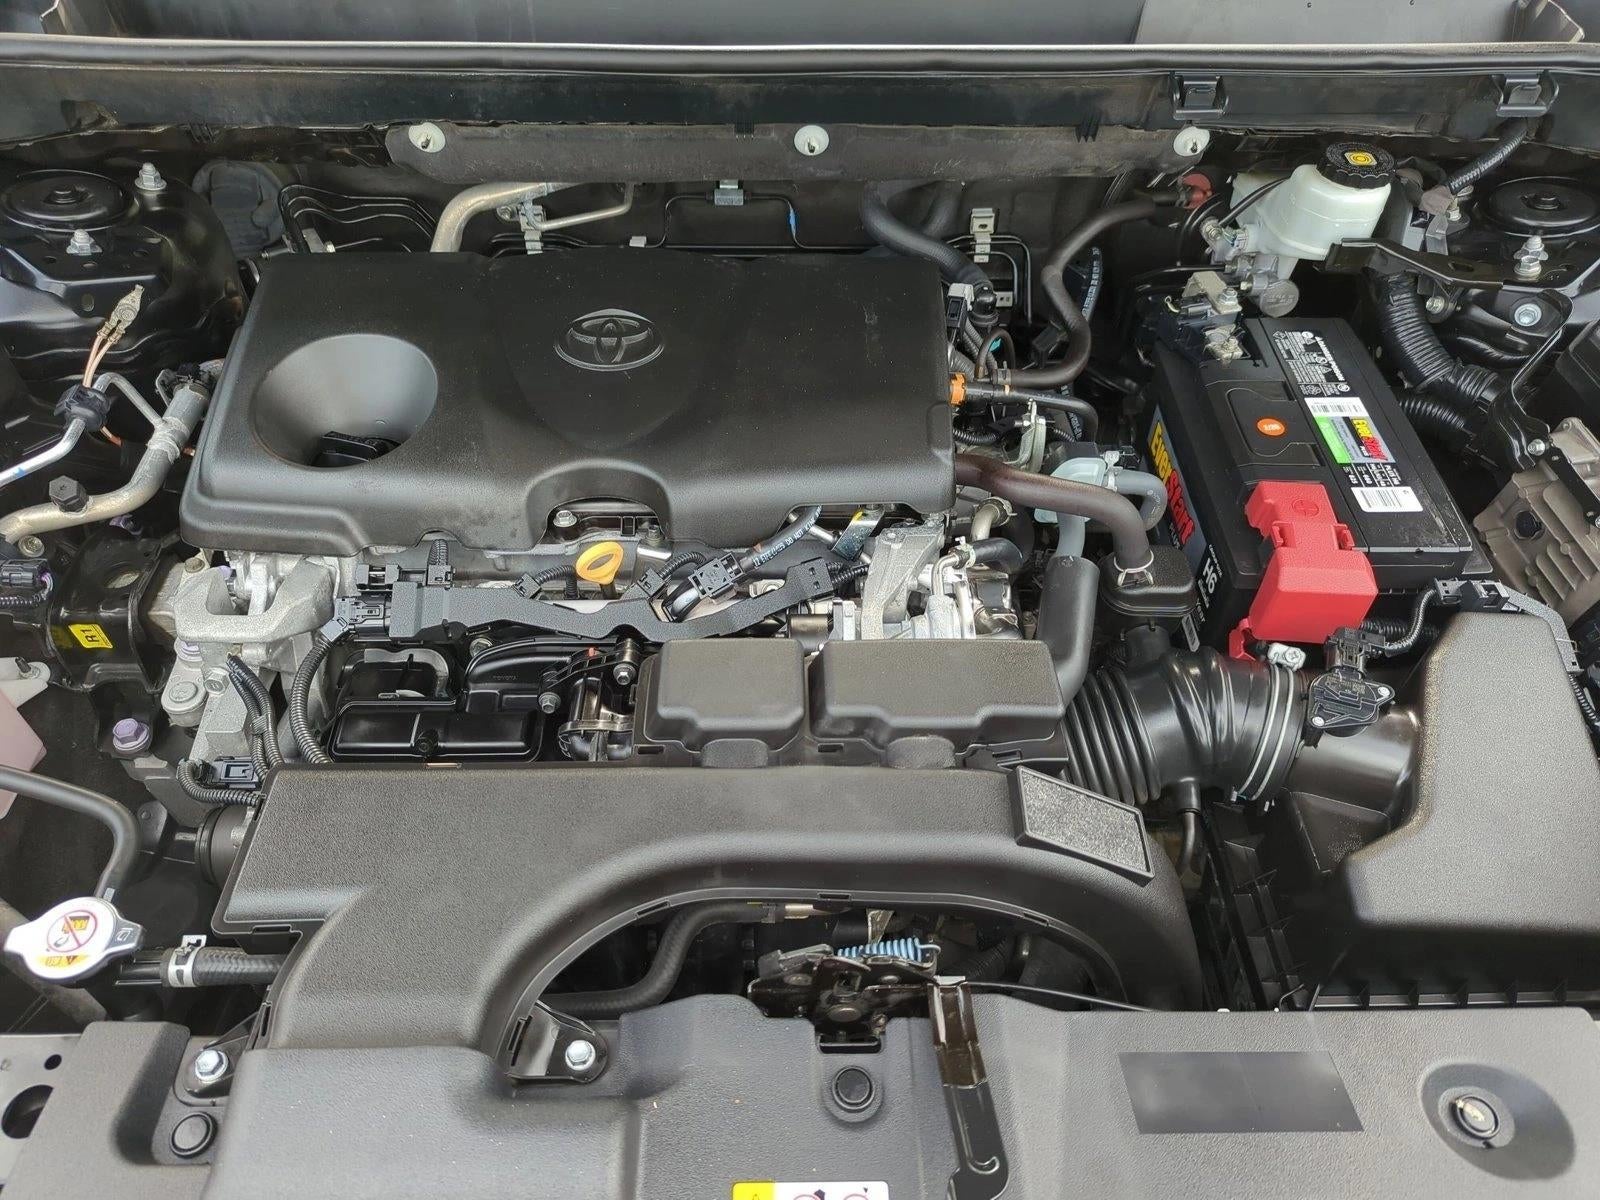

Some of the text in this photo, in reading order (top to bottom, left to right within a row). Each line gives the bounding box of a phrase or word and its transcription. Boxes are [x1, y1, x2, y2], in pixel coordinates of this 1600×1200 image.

[1352, 419, 1388, 461] EverStart
[1150, 421, 1194, 545] EverStart
[1203, 558, 1217, 594] H6
[80, 629, 100, 643] R1
